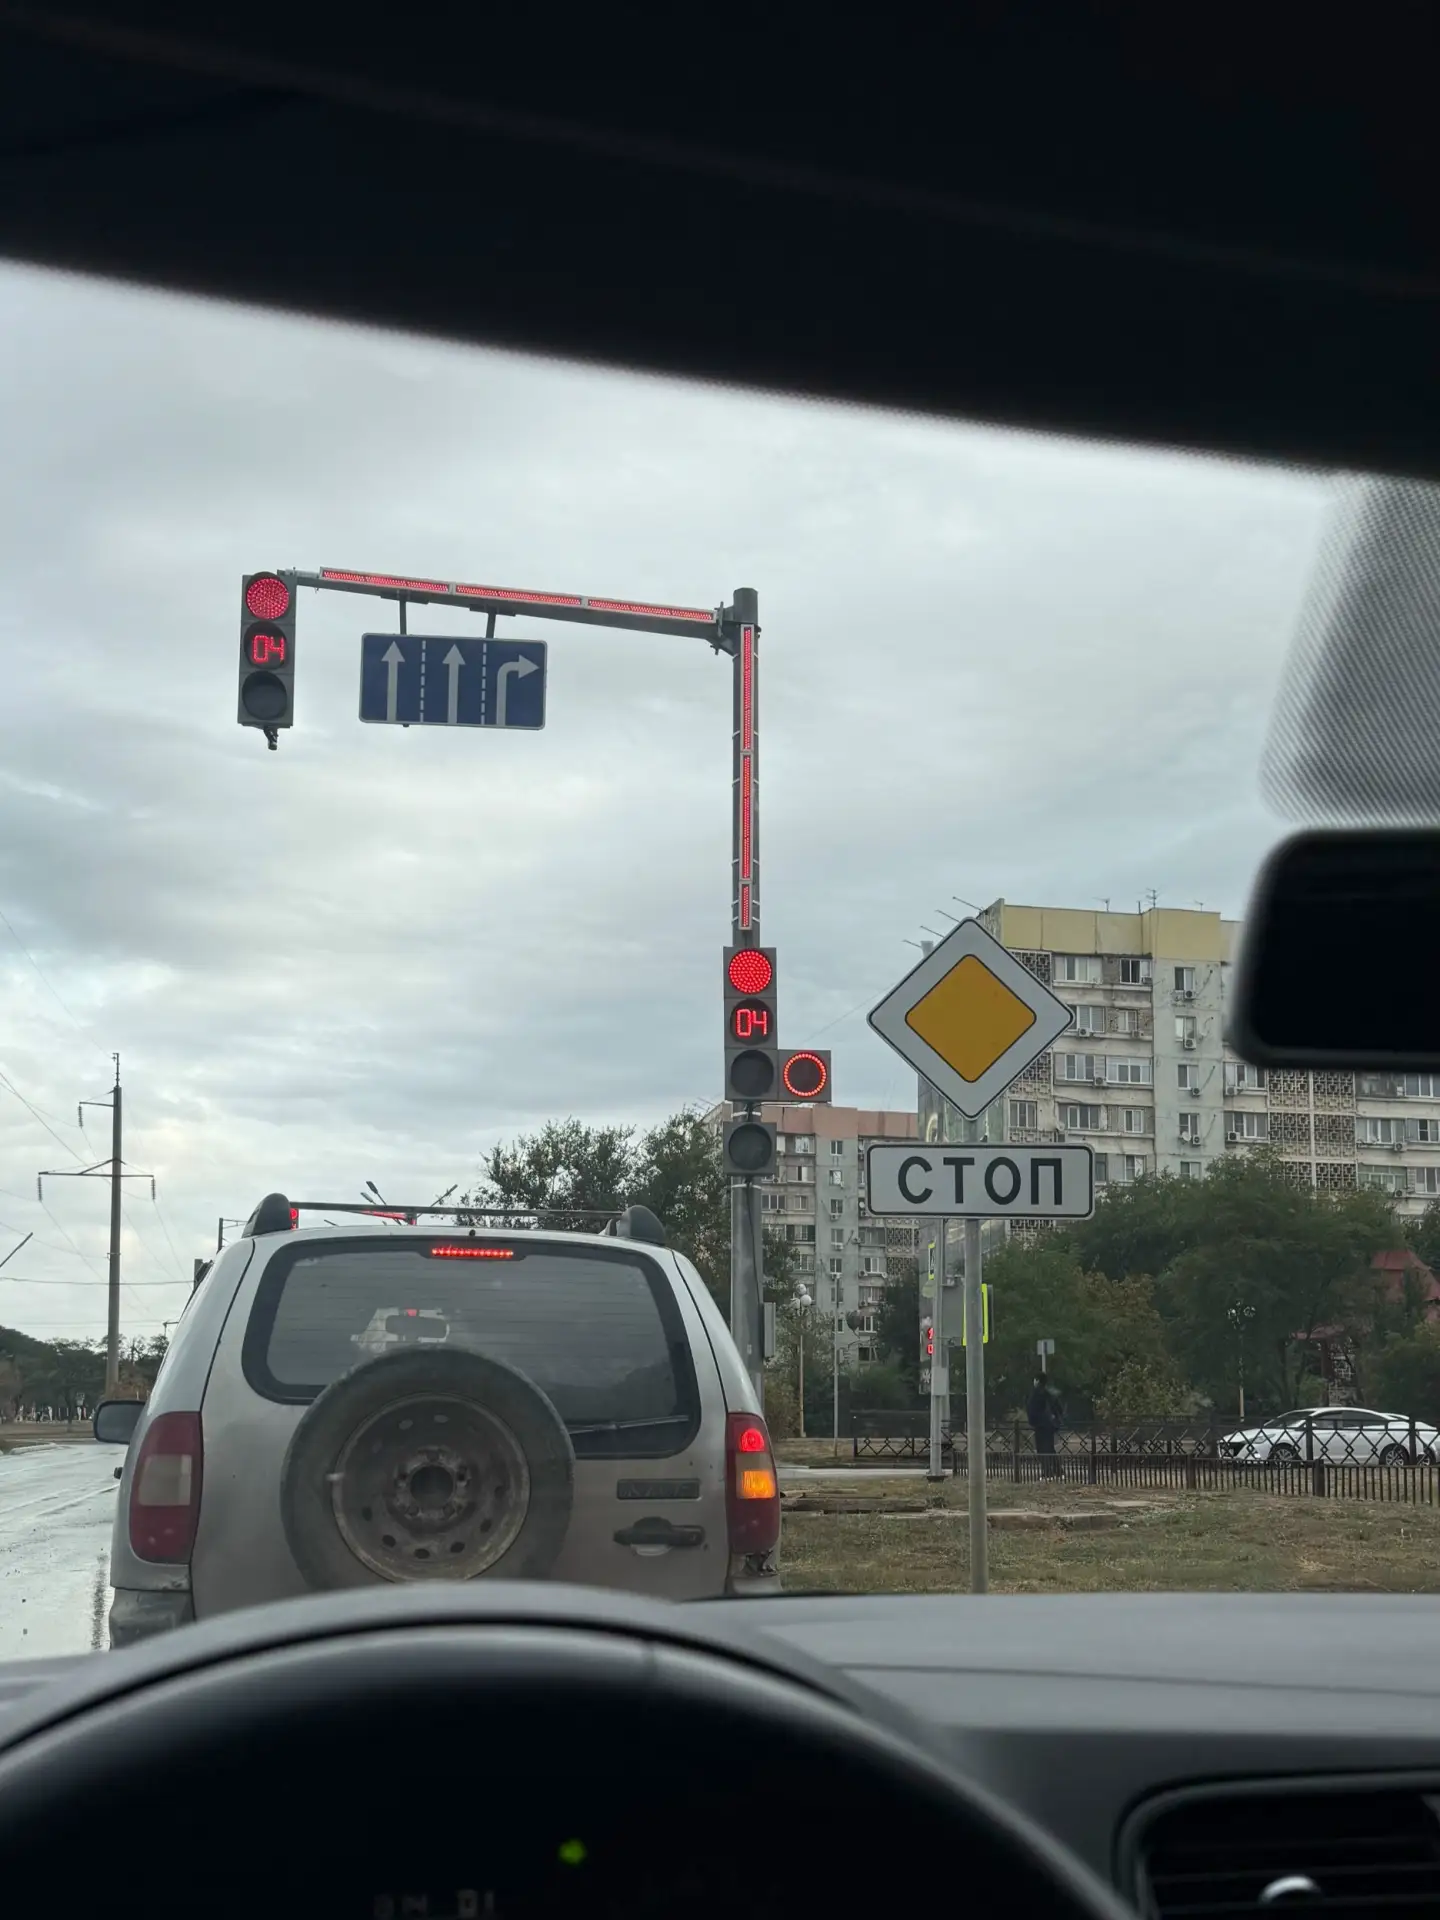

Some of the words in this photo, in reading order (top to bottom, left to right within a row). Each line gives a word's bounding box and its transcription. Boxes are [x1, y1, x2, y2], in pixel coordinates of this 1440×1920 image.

[253, 635, 284, 662] 04
[736, 1009, 767, 1036] 04
[898, 1156, 1062, 1205] СТОП
